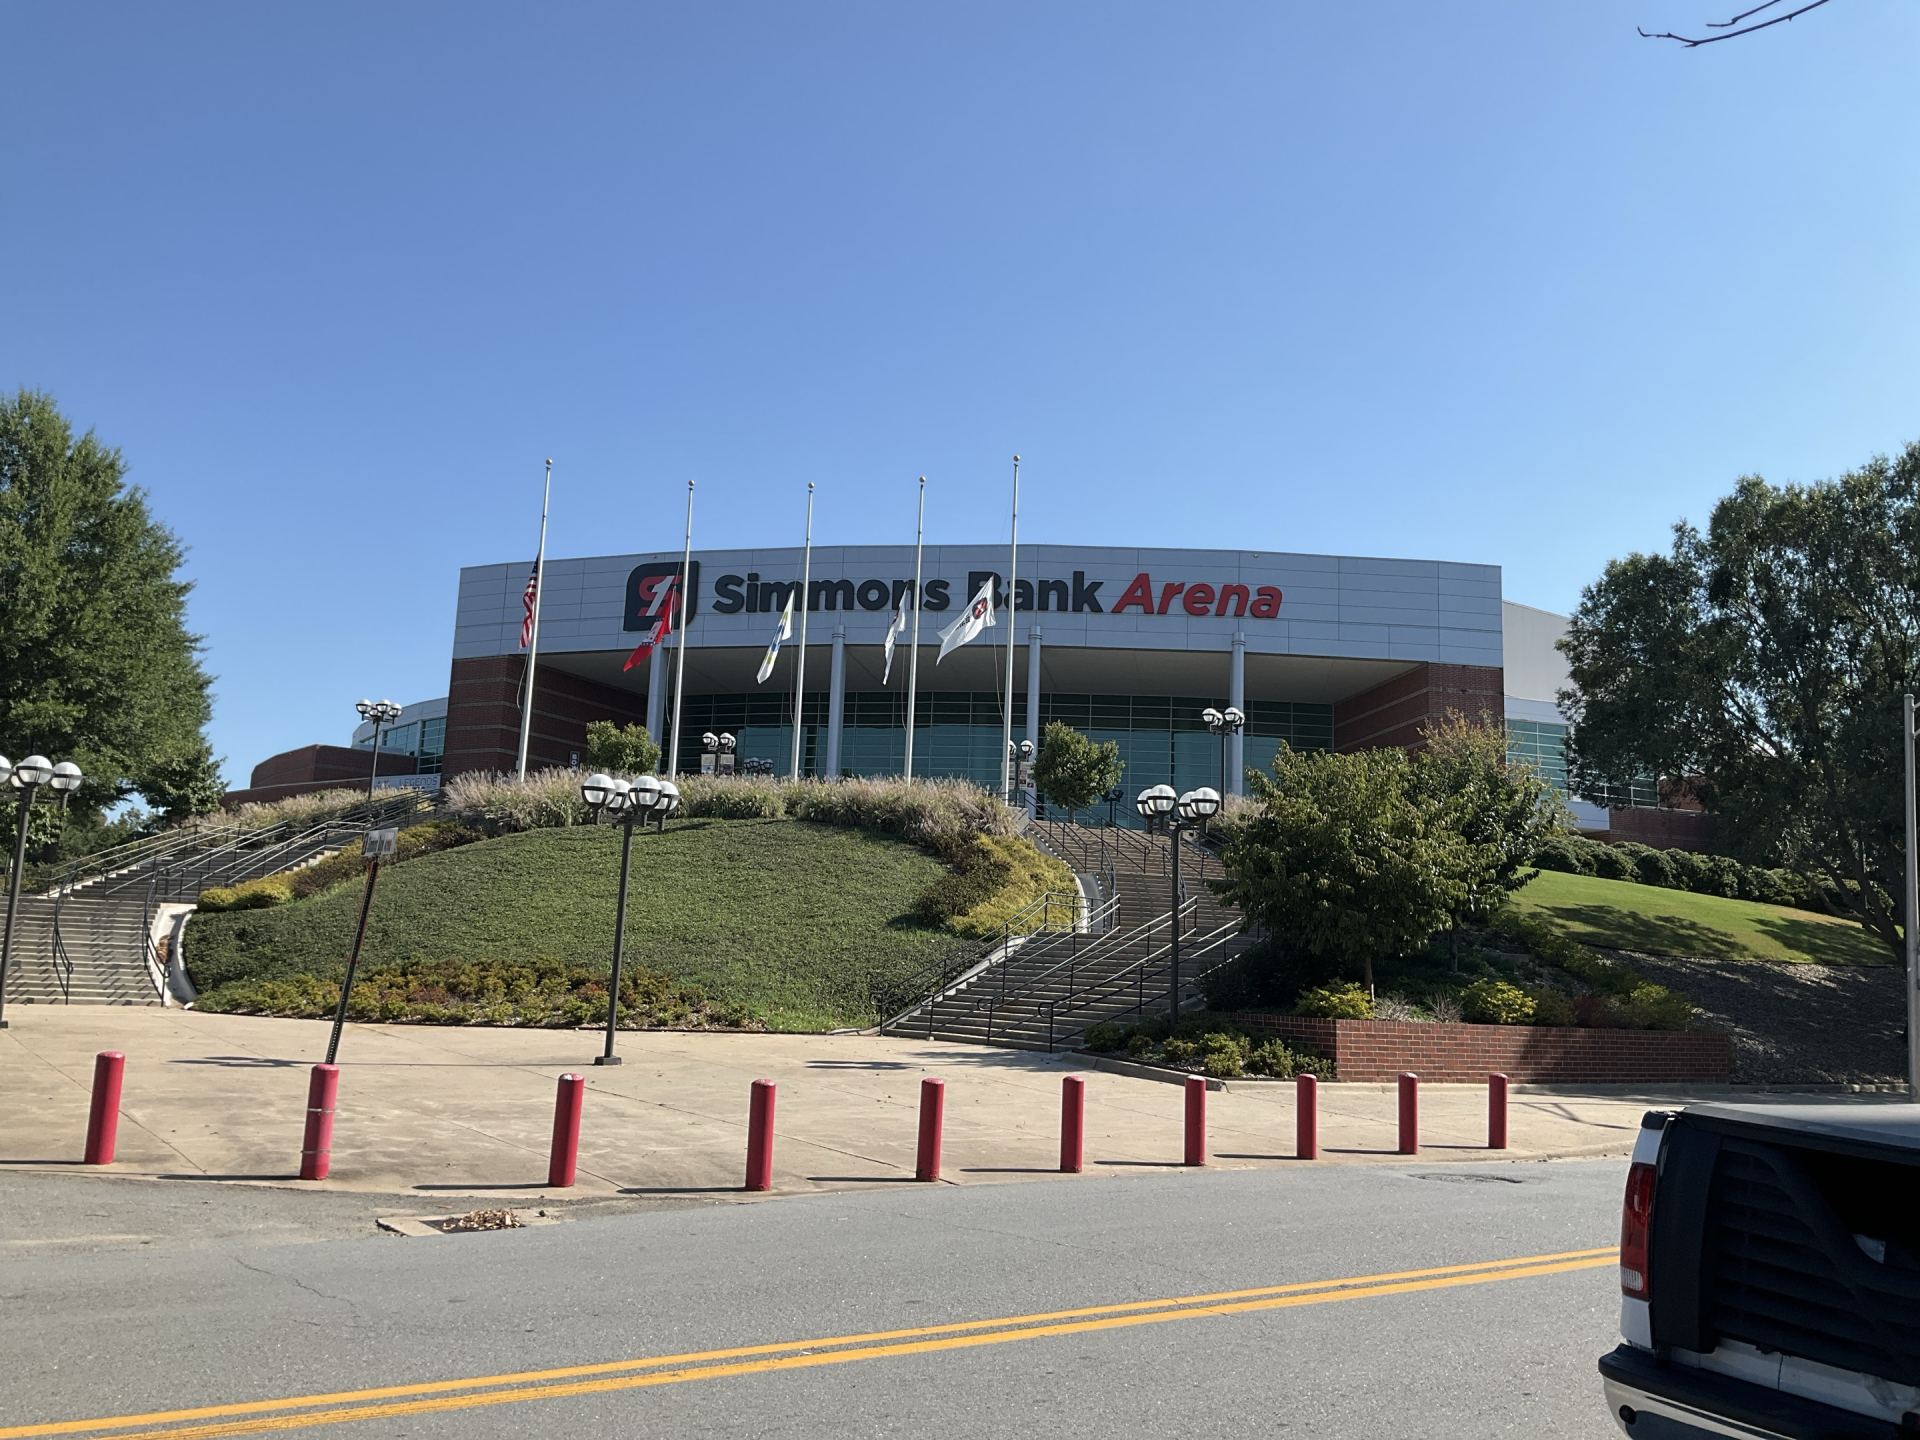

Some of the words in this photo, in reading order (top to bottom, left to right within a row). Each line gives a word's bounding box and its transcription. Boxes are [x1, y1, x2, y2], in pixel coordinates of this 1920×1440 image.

[712, 573, 950, 614] Simmons
[967, 571, 1104, 613] Bank
[1111, 573, 1283, 618] Arena
[399, 776, 438, 787] LEGENDS
